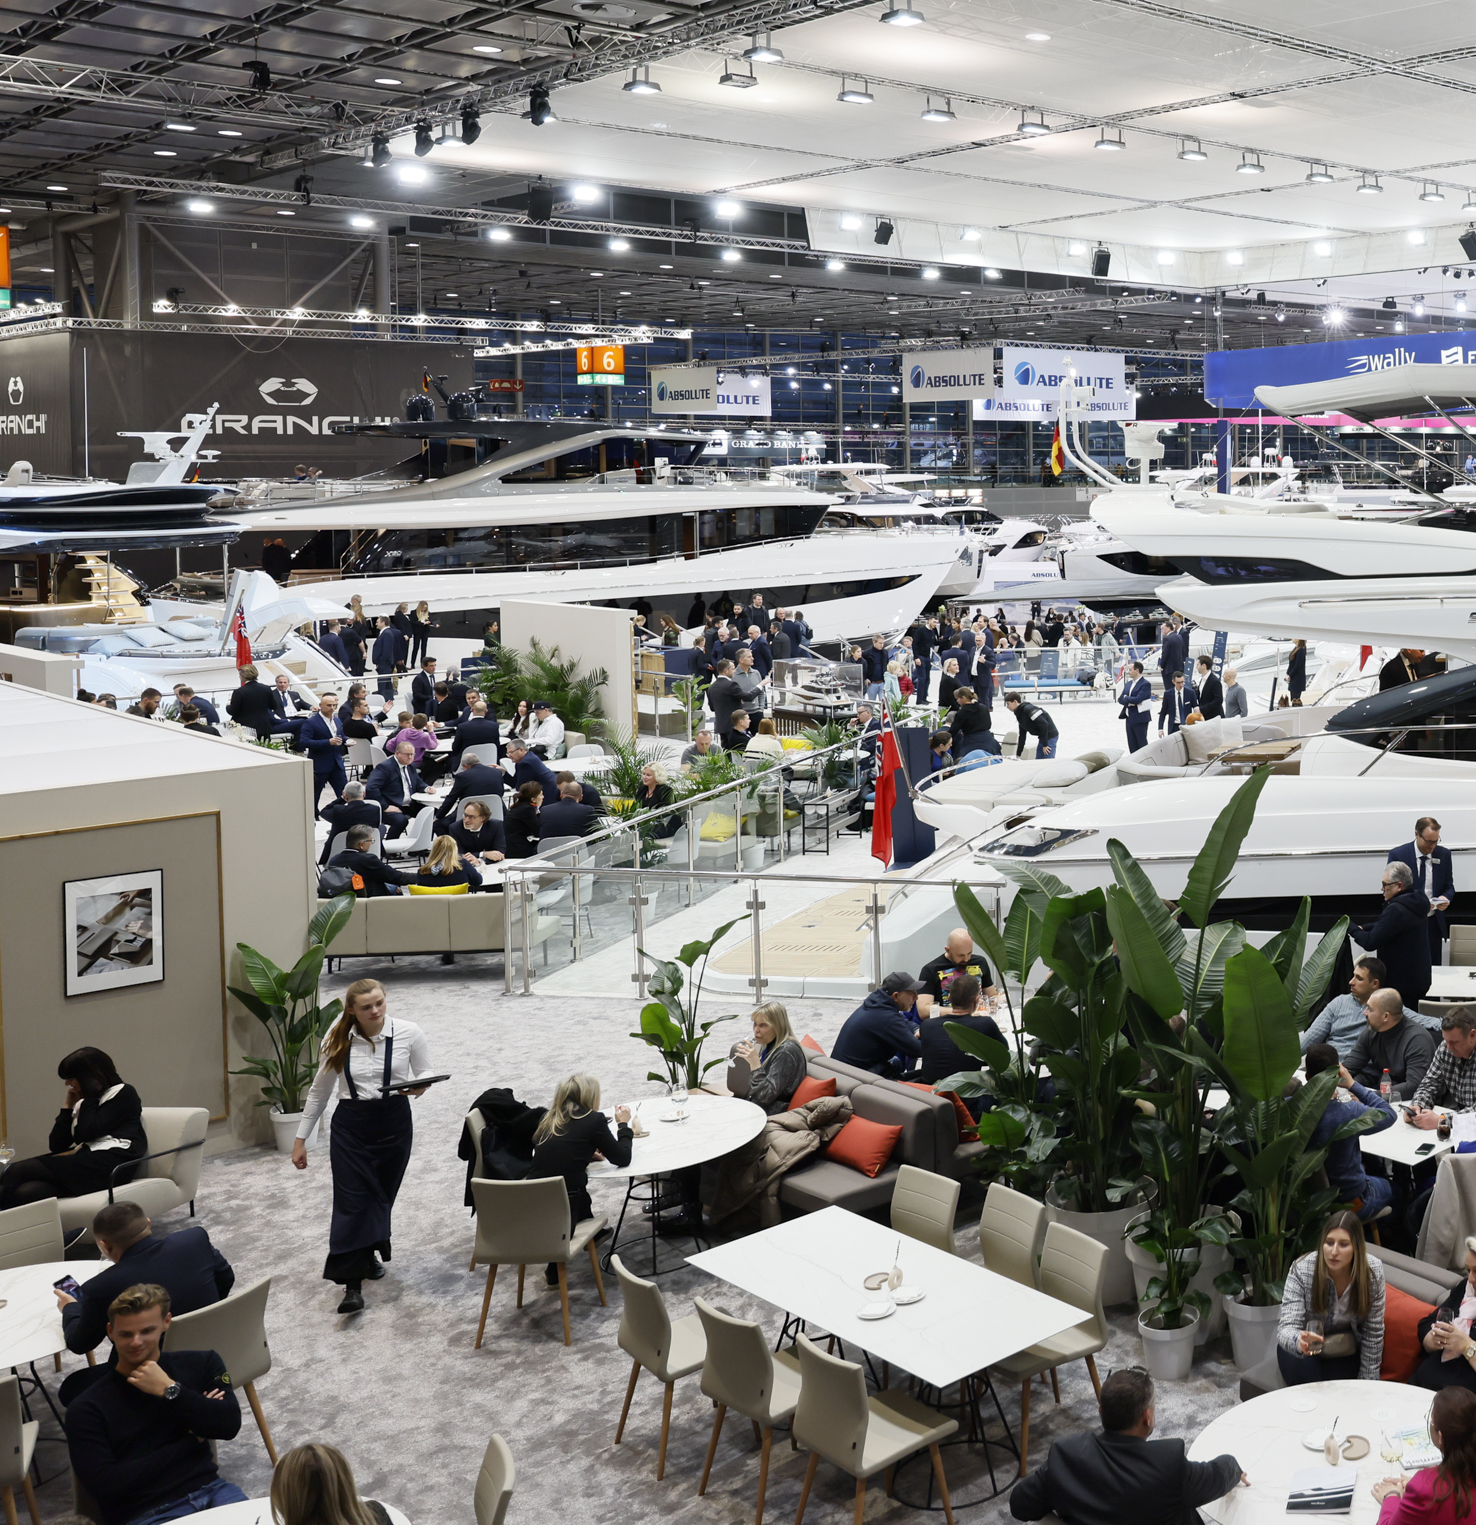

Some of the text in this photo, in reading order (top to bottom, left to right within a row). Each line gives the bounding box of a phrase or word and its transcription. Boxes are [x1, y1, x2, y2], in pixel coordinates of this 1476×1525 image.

[581, 351, 589, 371] 6
[602, 351, 615, 371] 6
[925, 373, 985, 389] ABSOLUTE
[667, 388, 711, 402] ABSOLUTE
[717, 394, 760, 405] OLUTE
[996, 401, 1053, 412] ABSOLUTE
[1086, 401, 1129, 412] BSOLUTE
[0, 413, 46, 435] RANCHI
[774, 440, 802, 448] BAN
